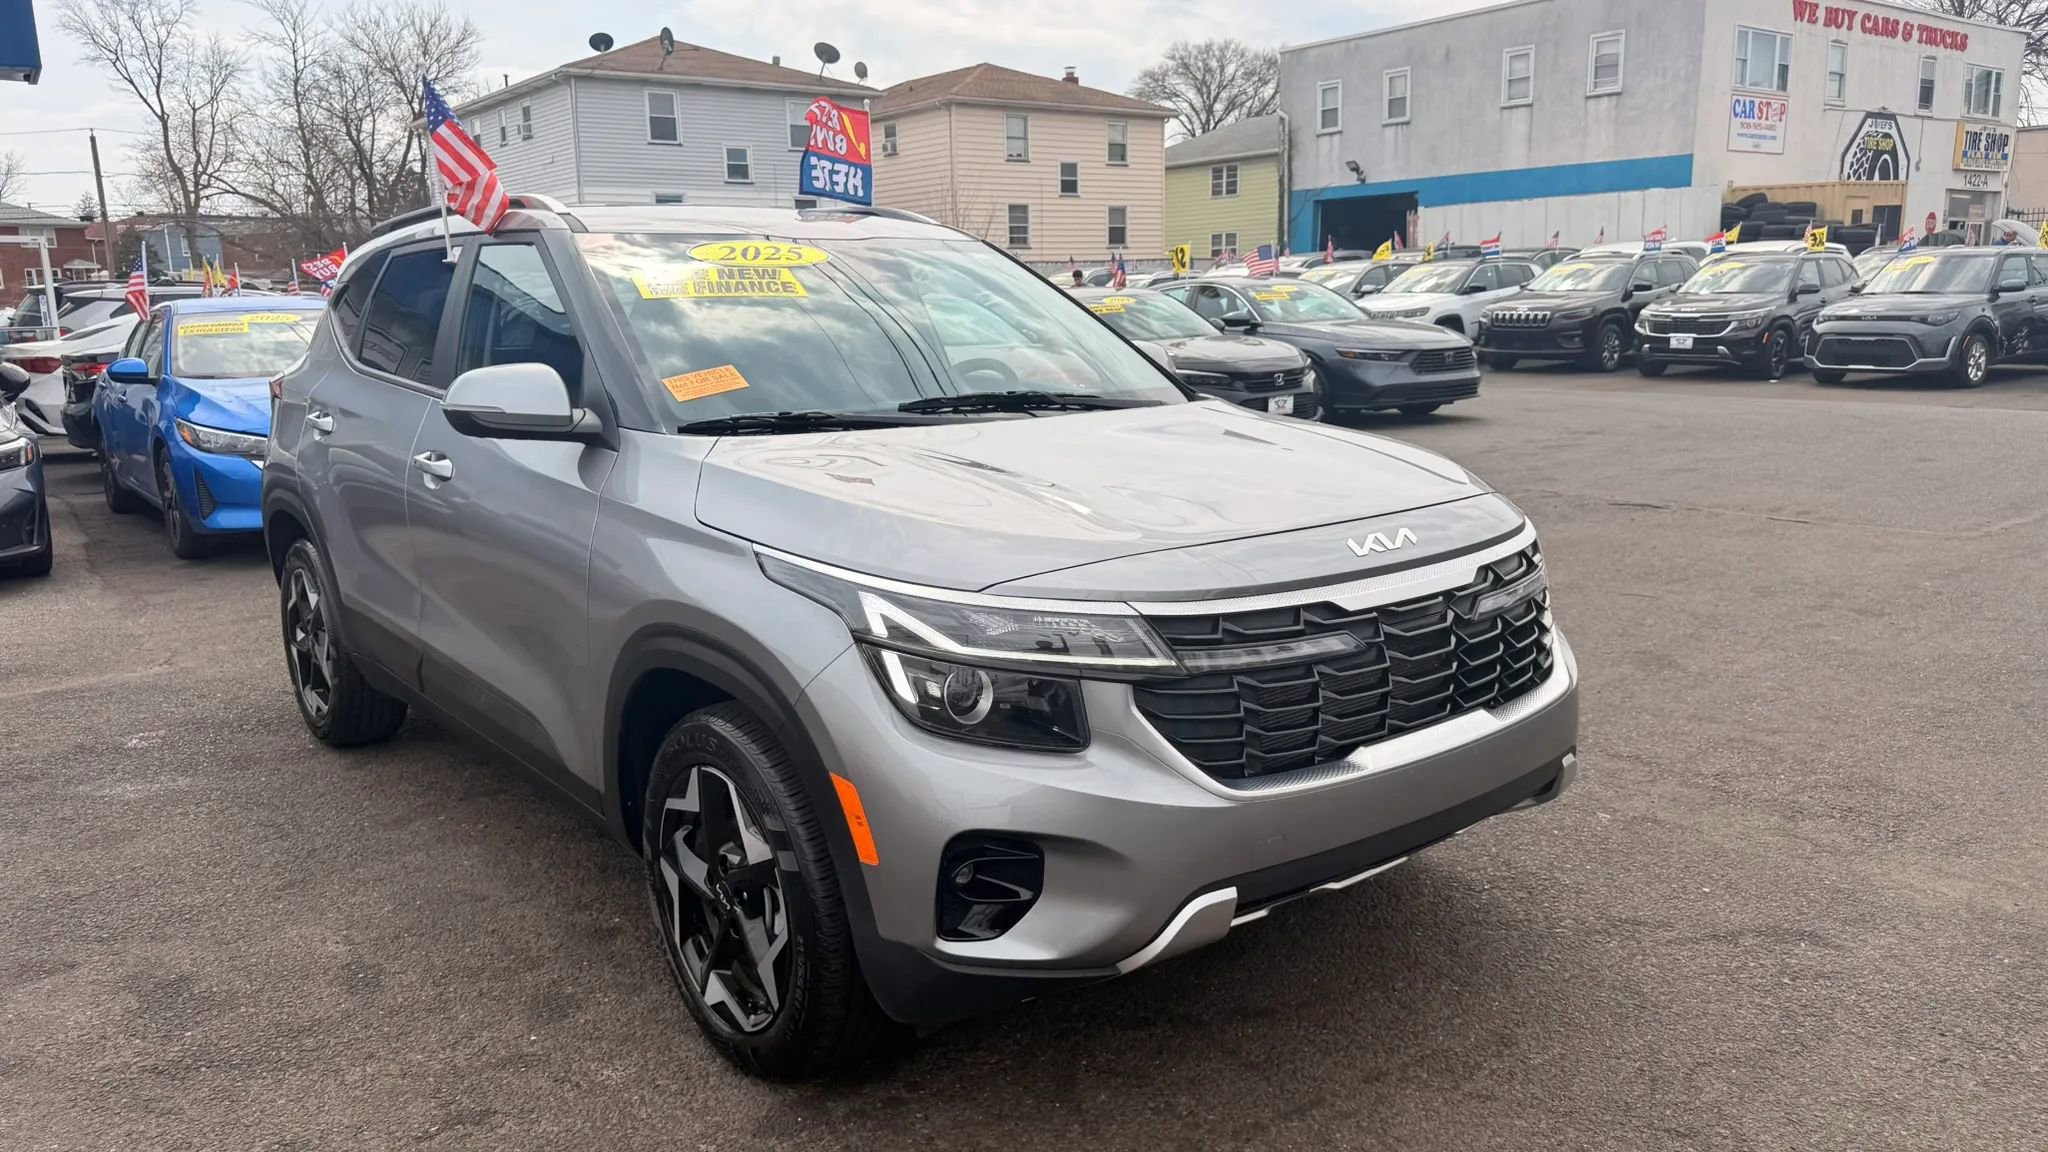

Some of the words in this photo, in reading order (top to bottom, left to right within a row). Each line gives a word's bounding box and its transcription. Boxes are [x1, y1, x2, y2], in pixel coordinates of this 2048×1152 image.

[1792, 0, 1819, 24] WE
[1823, 6, 1857, 31] BUY
[1860, 13, 1900, 39] CARS
[1902, 21, 1914, 42] &
[1917, 23, 1968, 51] TRUCKS
[1733, 98, 1755, 120] CAR
[1965, 130, 1983, 151] TIRE
[1984, 132, 2009, 153] SHOP
[1963, 173, 1988, 188] 1422-A
[718, 245, 804, 262] 2025
[717, 268, 780, 281] NEW
[694, 281, 798, 295] FINANCE
